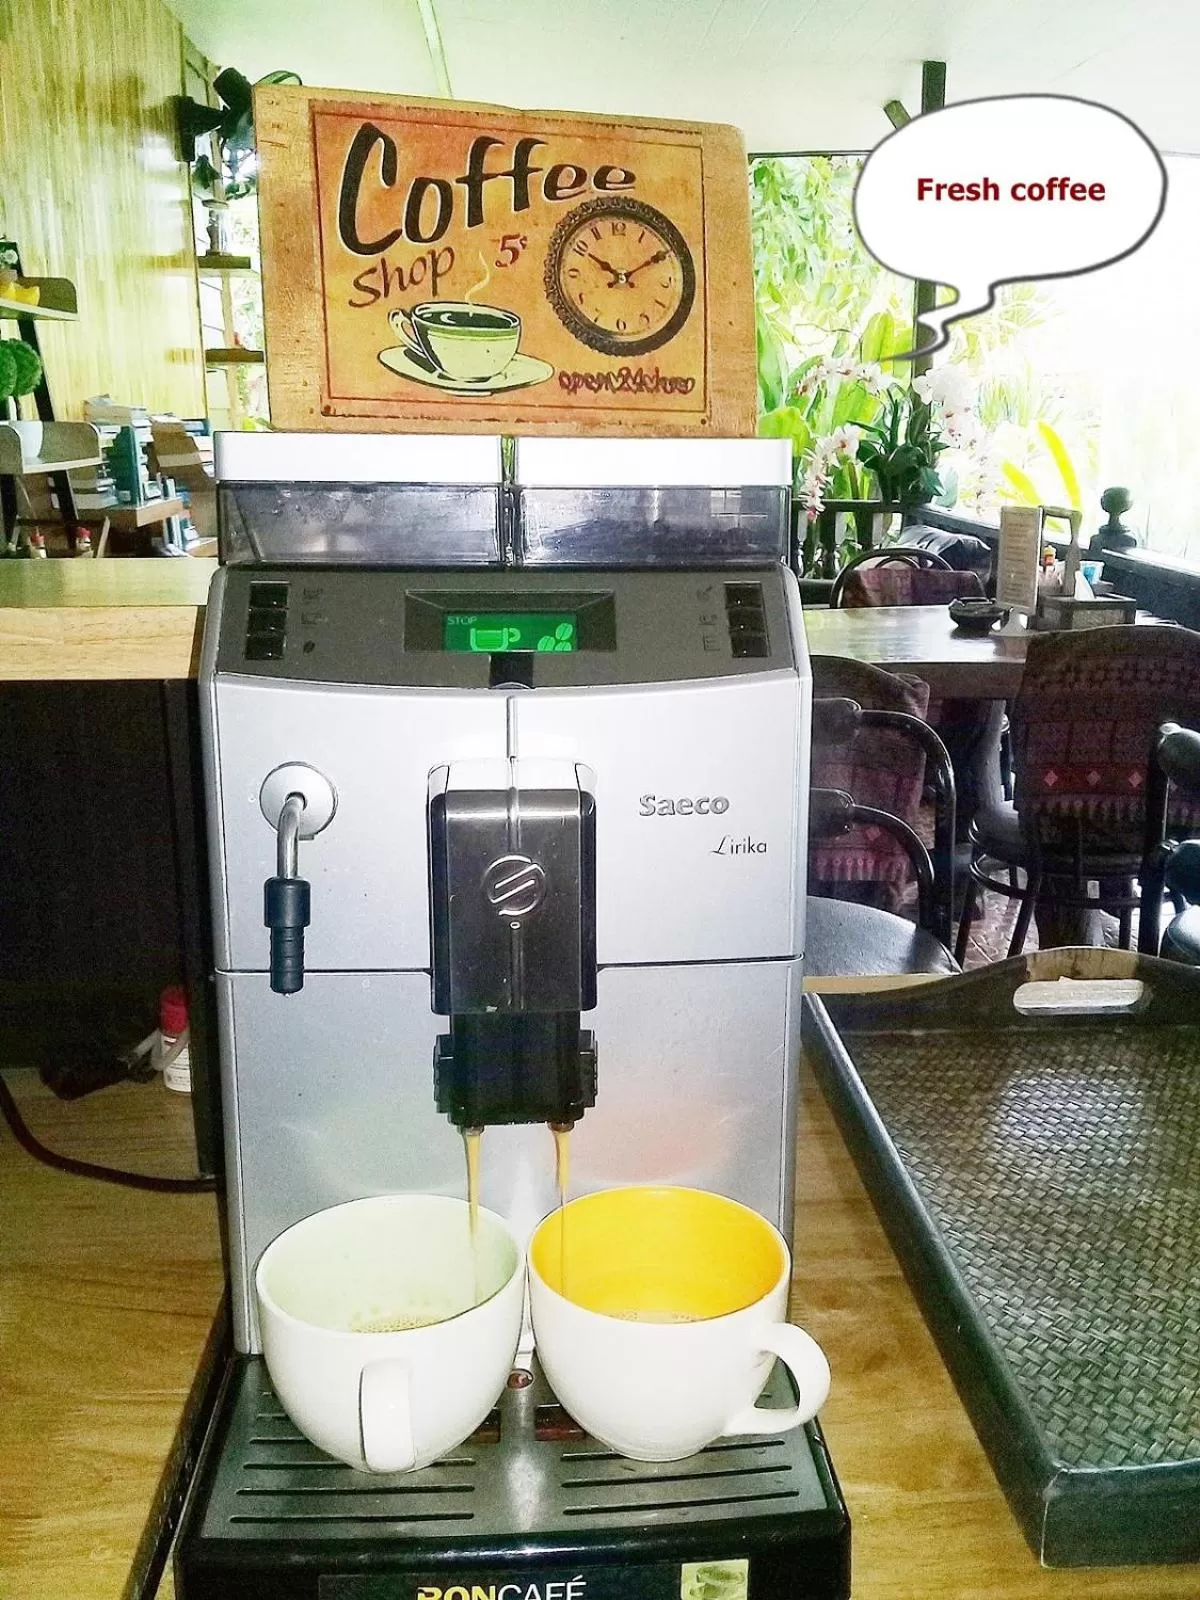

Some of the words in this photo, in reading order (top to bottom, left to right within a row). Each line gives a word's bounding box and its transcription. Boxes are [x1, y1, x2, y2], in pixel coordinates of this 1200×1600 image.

[339, 122, 637, 256] Coffee
[348, 247, 456, 308] shop
[447, 615, 477, 625] STOP
[639, 793, 730, 817] Saeco
[710, 834, 768, 855] Lirika
